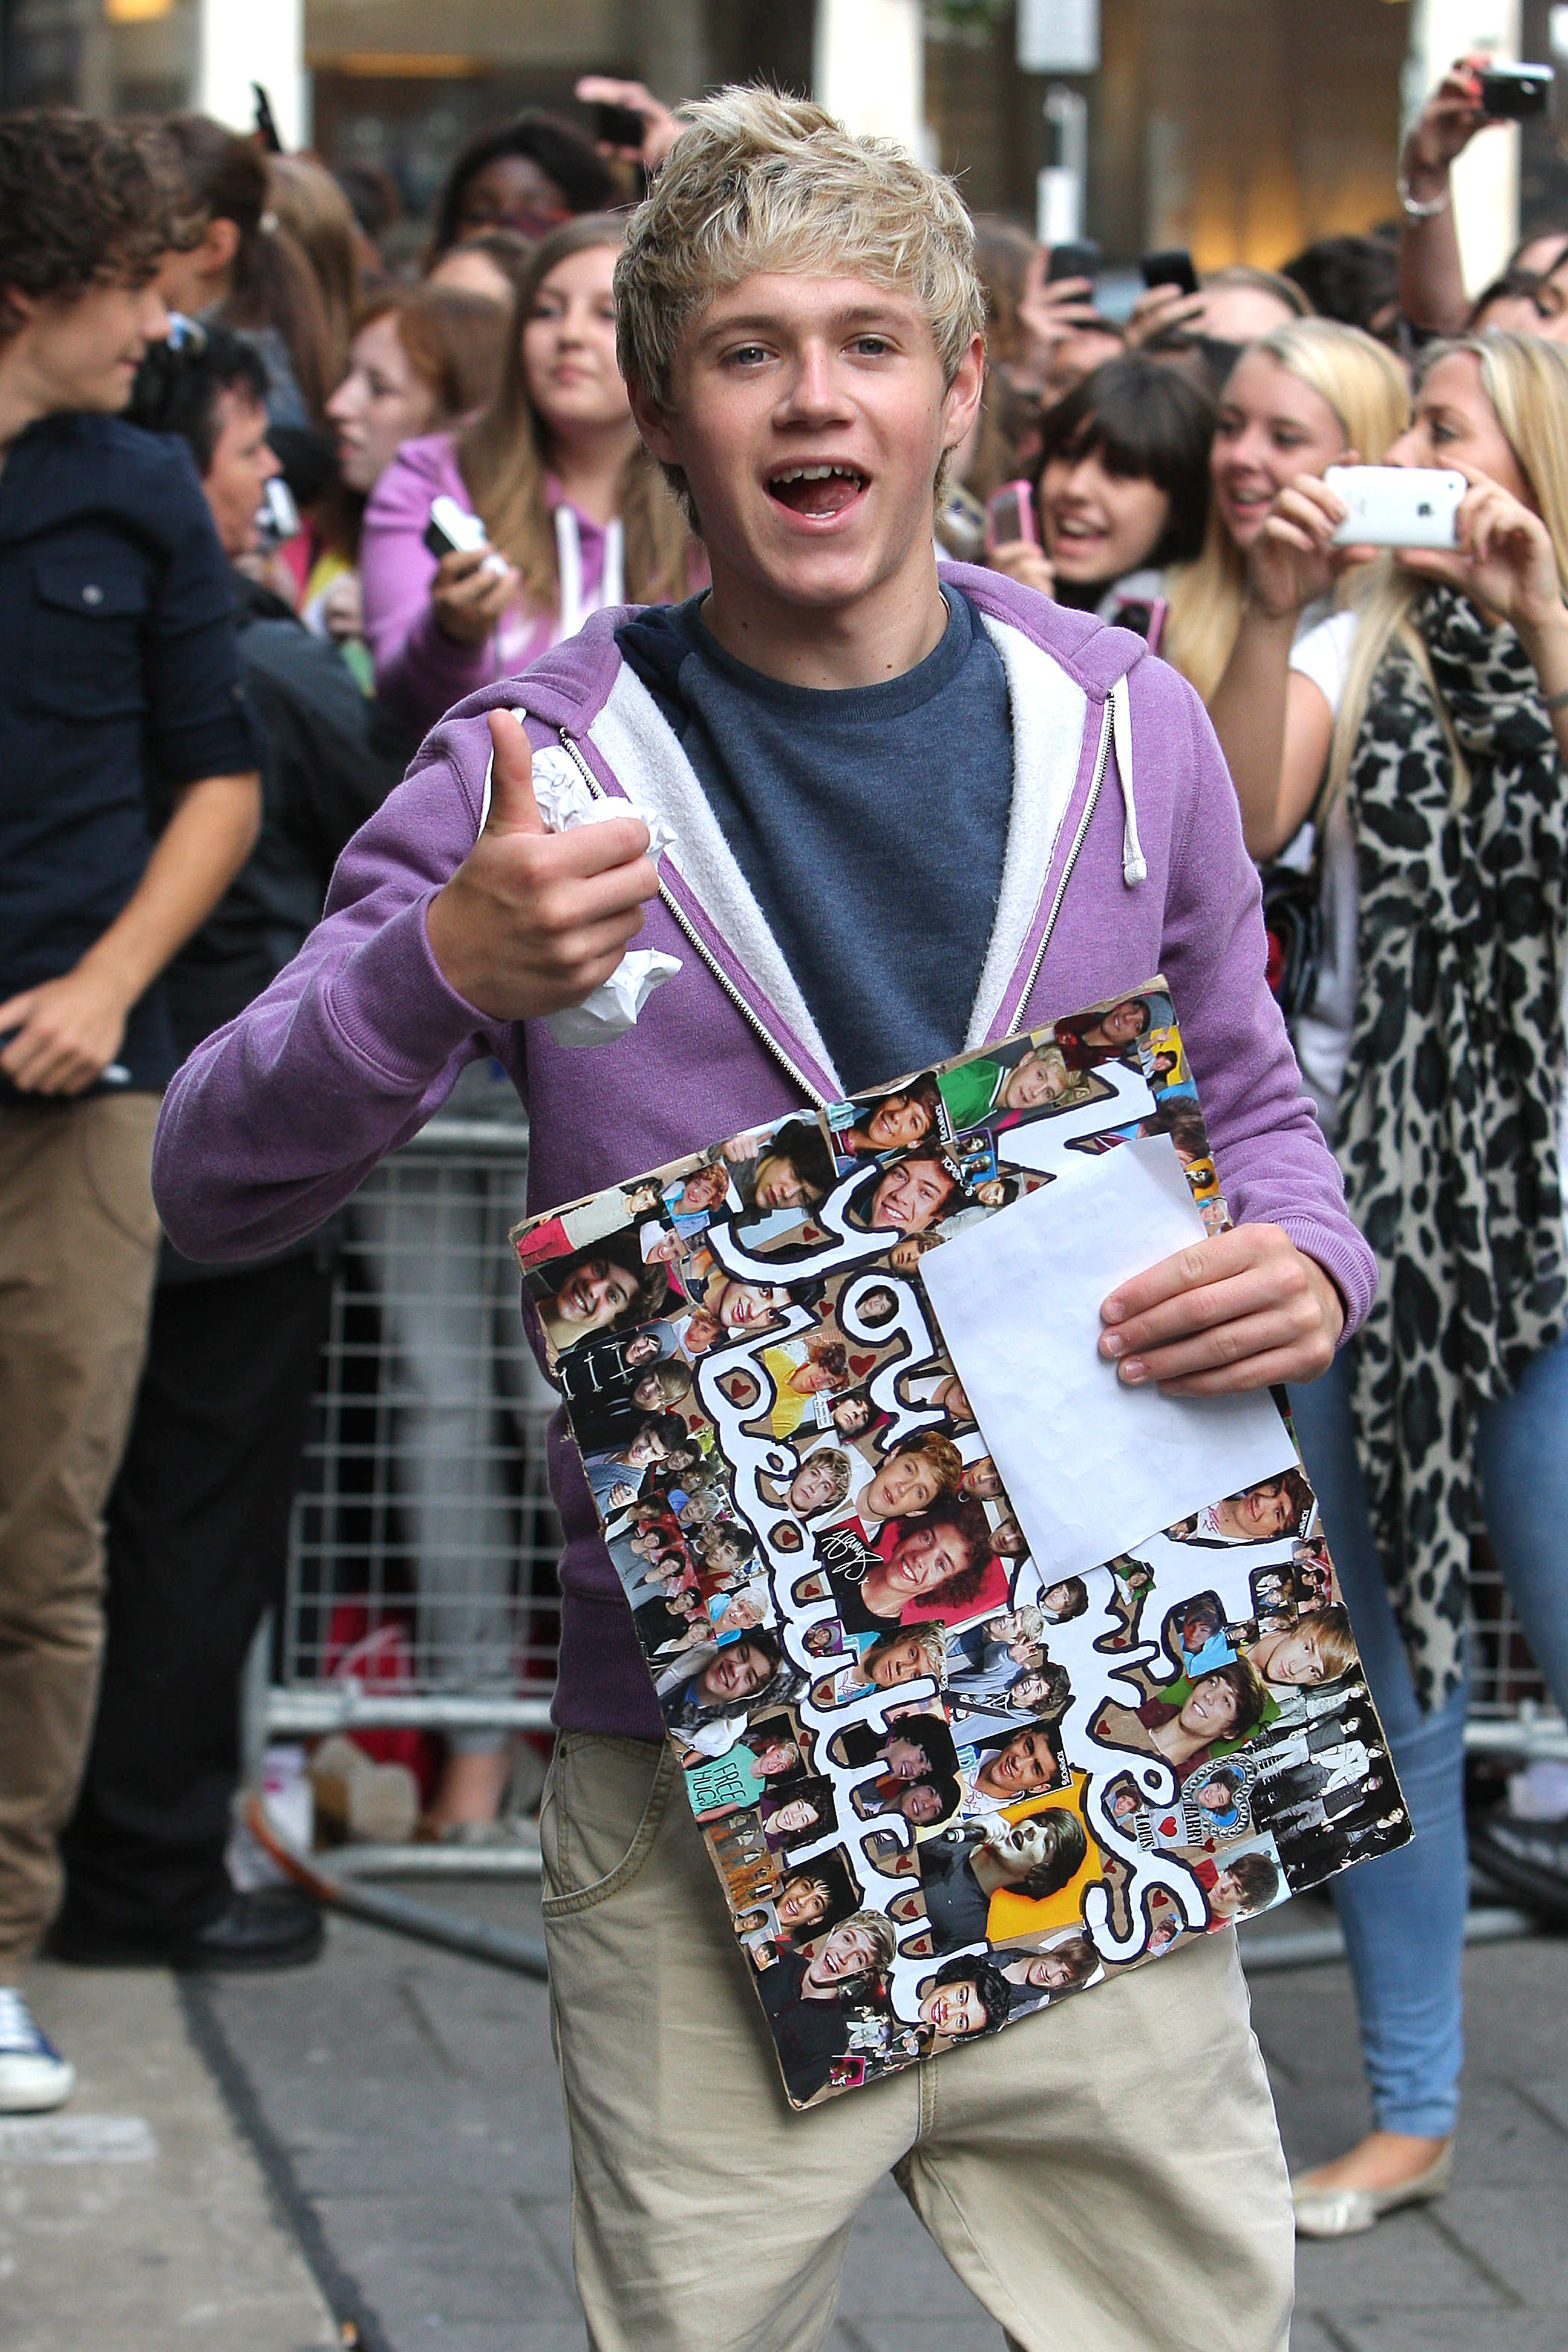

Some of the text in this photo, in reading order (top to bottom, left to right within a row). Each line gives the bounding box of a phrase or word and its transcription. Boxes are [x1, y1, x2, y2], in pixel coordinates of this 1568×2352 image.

[694, 1301, 992, 2025] beautiful
[713, 1762, 746, 1802] FREE
[1007, 1558, 1211, 1966] akes
[693, 1769, 720, 1807] HUGS
[1183, 1803, 1203, 1845] HARRY
